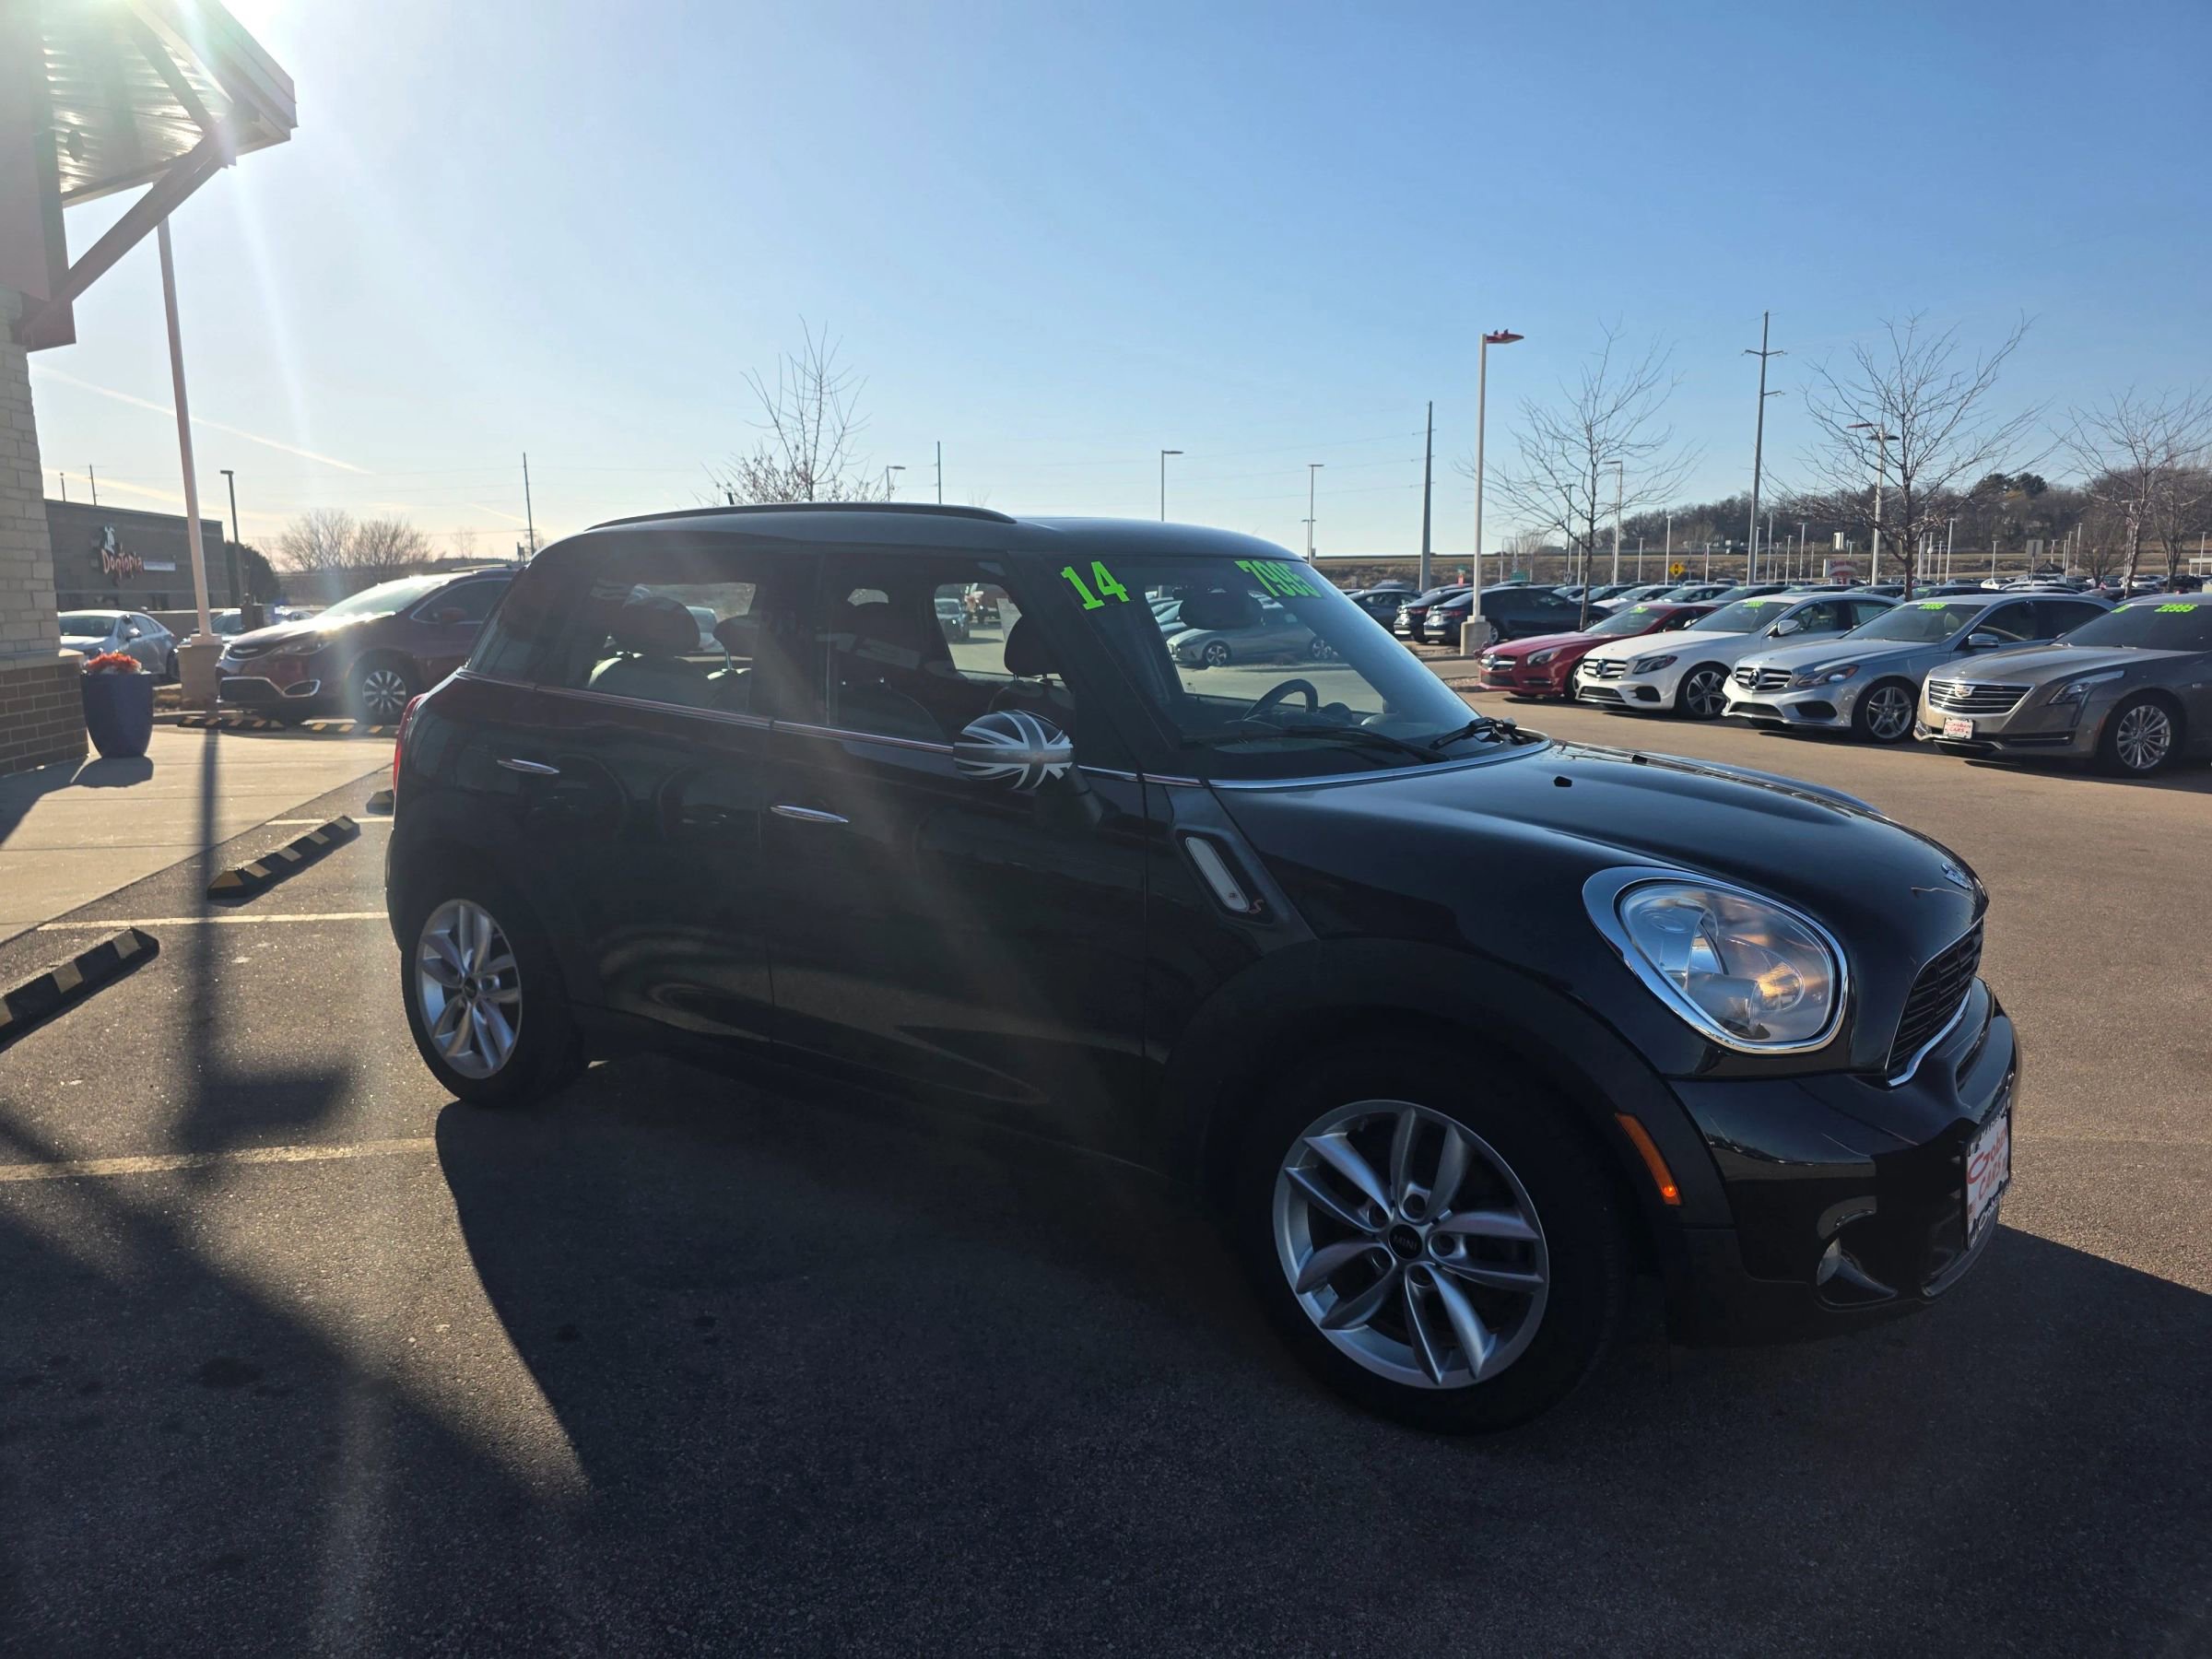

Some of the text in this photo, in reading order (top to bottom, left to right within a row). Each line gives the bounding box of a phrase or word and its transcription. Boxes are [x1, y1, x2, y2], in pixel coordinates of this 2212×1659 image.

[101, 543, 144, 581] Dogtopia
[1234, 559, 1322, 597] 7995
[1061, 560, 1129, 610] 14
